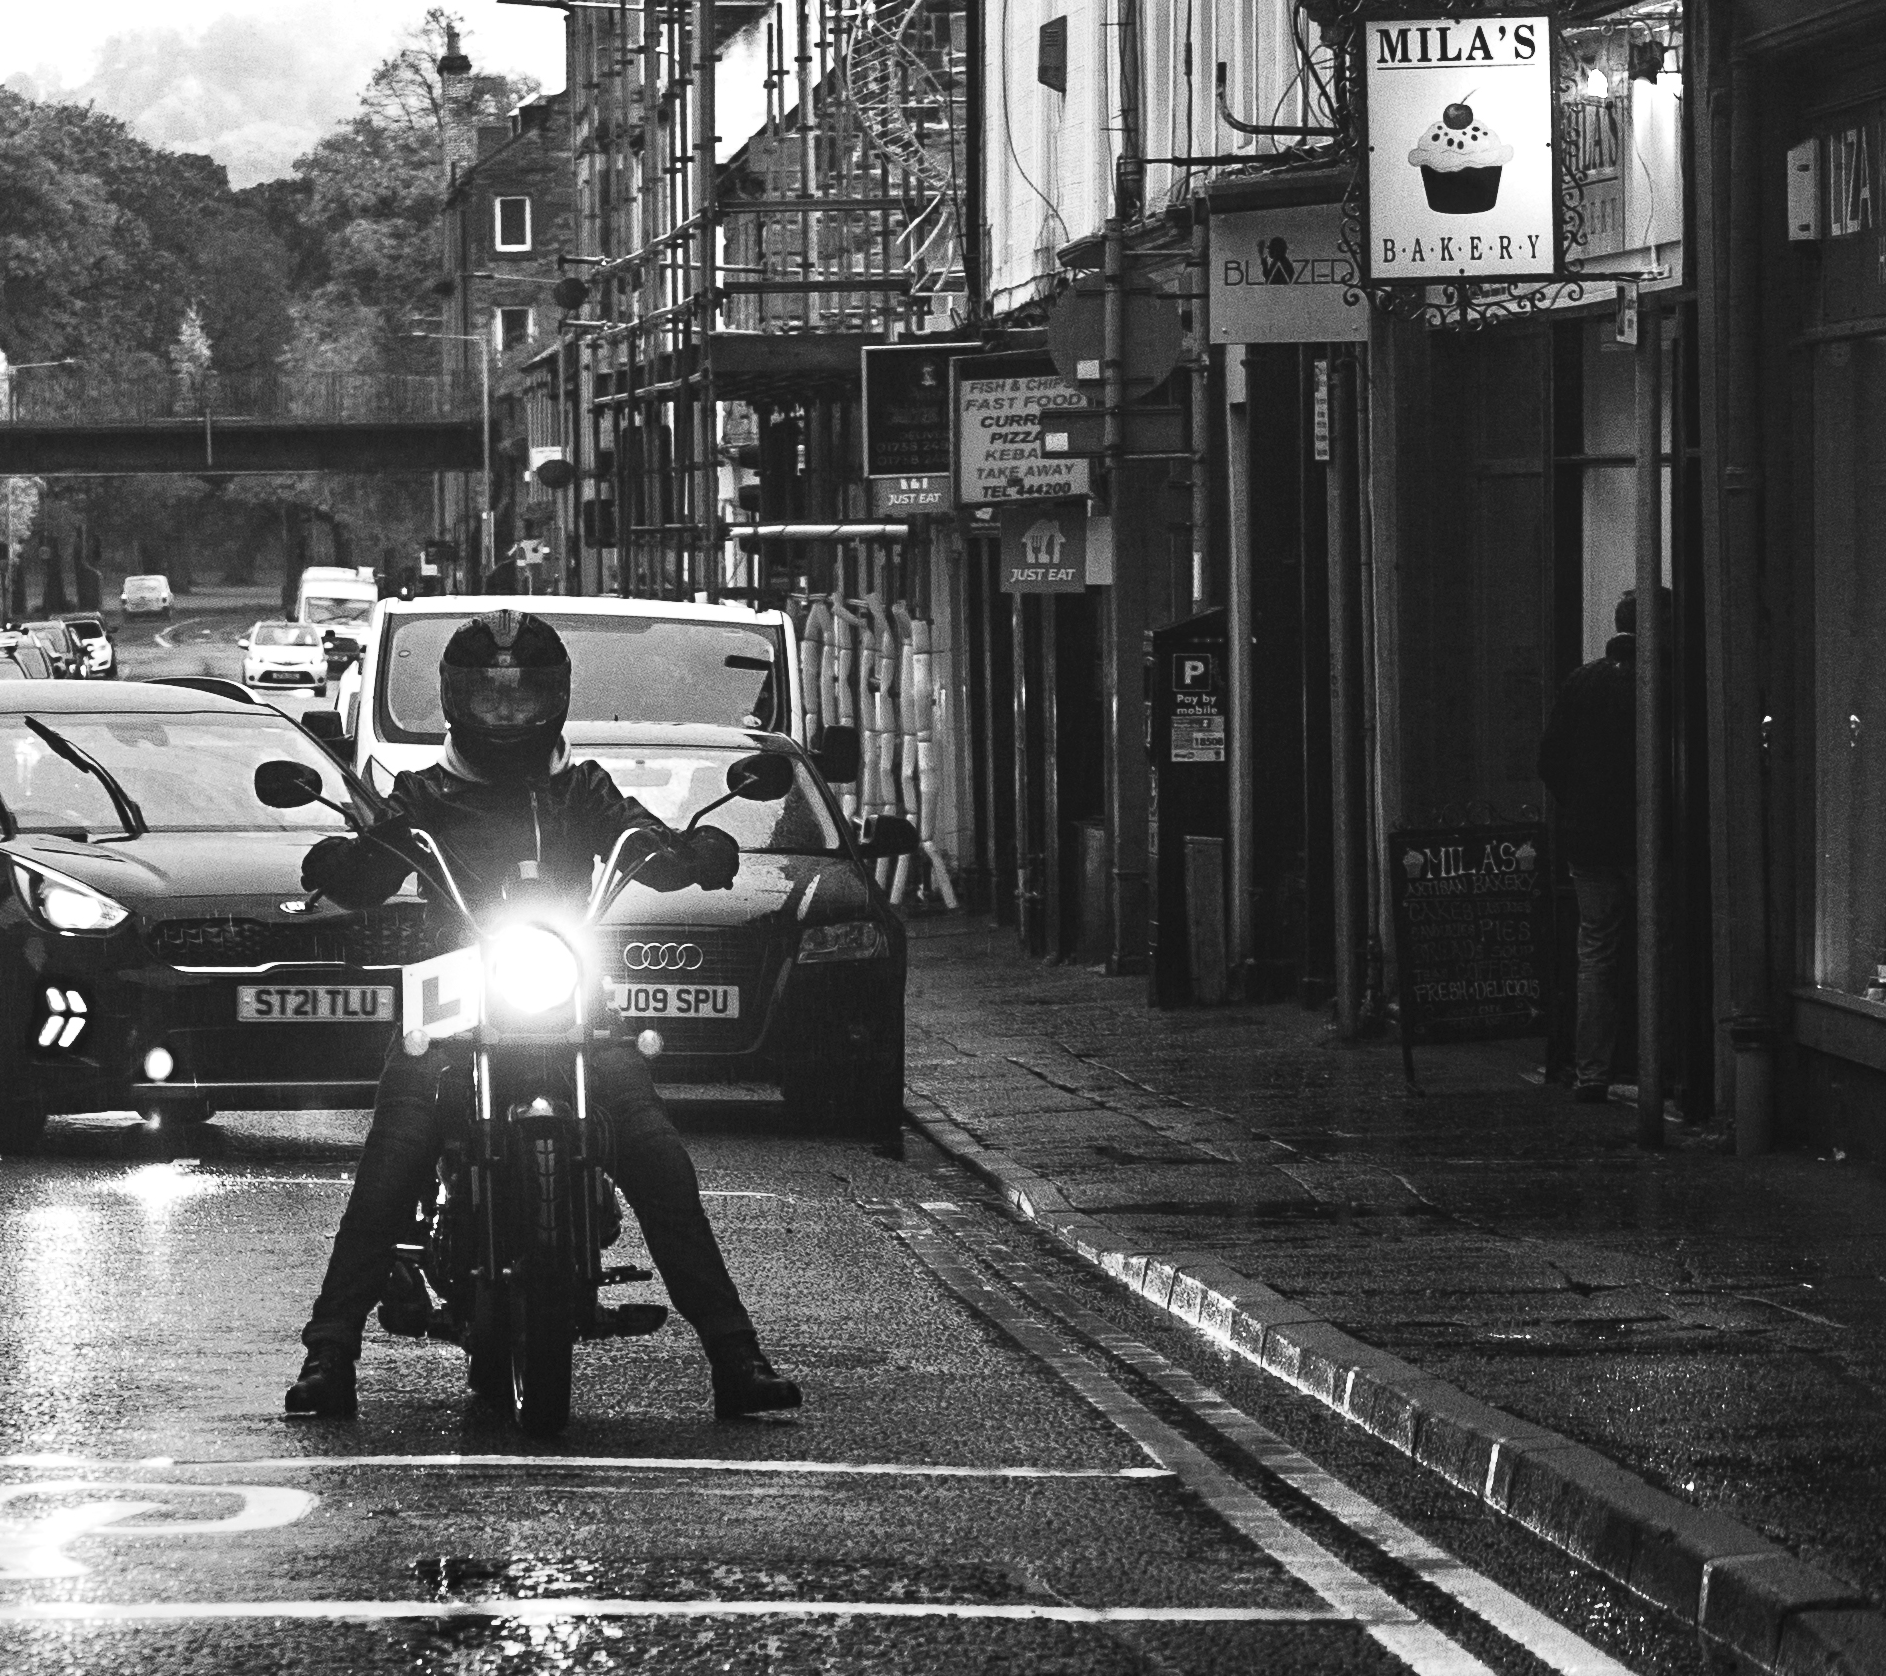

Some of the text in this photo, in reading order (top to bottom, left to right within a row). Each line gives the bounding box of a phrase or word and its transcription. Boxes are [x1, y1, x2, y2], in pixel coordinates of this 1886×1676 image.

[1376, 24, 1536, 64] MILA'S
[1225, 258, 1356, 287] BLAZED
[970, 380, 1006, 395] FISH
[1010, 379, 1021, 392] &
[964, 393, 1083, 412] FAST FOOD
[980, 413, 1042, 428] CURR
[984, 447, 1040, 462] KEBA
[976, 463, 1075, 480] TAKE AWAY
[888, 492, 942, 506] JUST EAT
[982, 484, 1011, 499] TEL
[1010, 569, 1076, 583] JUST EAT
[1184, 660, 1205, 684] P
[1177, 693, 1217, 705] Pay by
[1177, 705, 1218, 714] mobile
[1423, 840, 1517, 878] MILA'S
[1405, 872, 1540, 898] ARTISAN BAKERY
[1480, 920, 1533, 942] PIES
[255, 989, 378, 1016] ST21 TLU
[422, 976, 461, 1026] L
[619, 988, 729, 1014] J09 SPU
